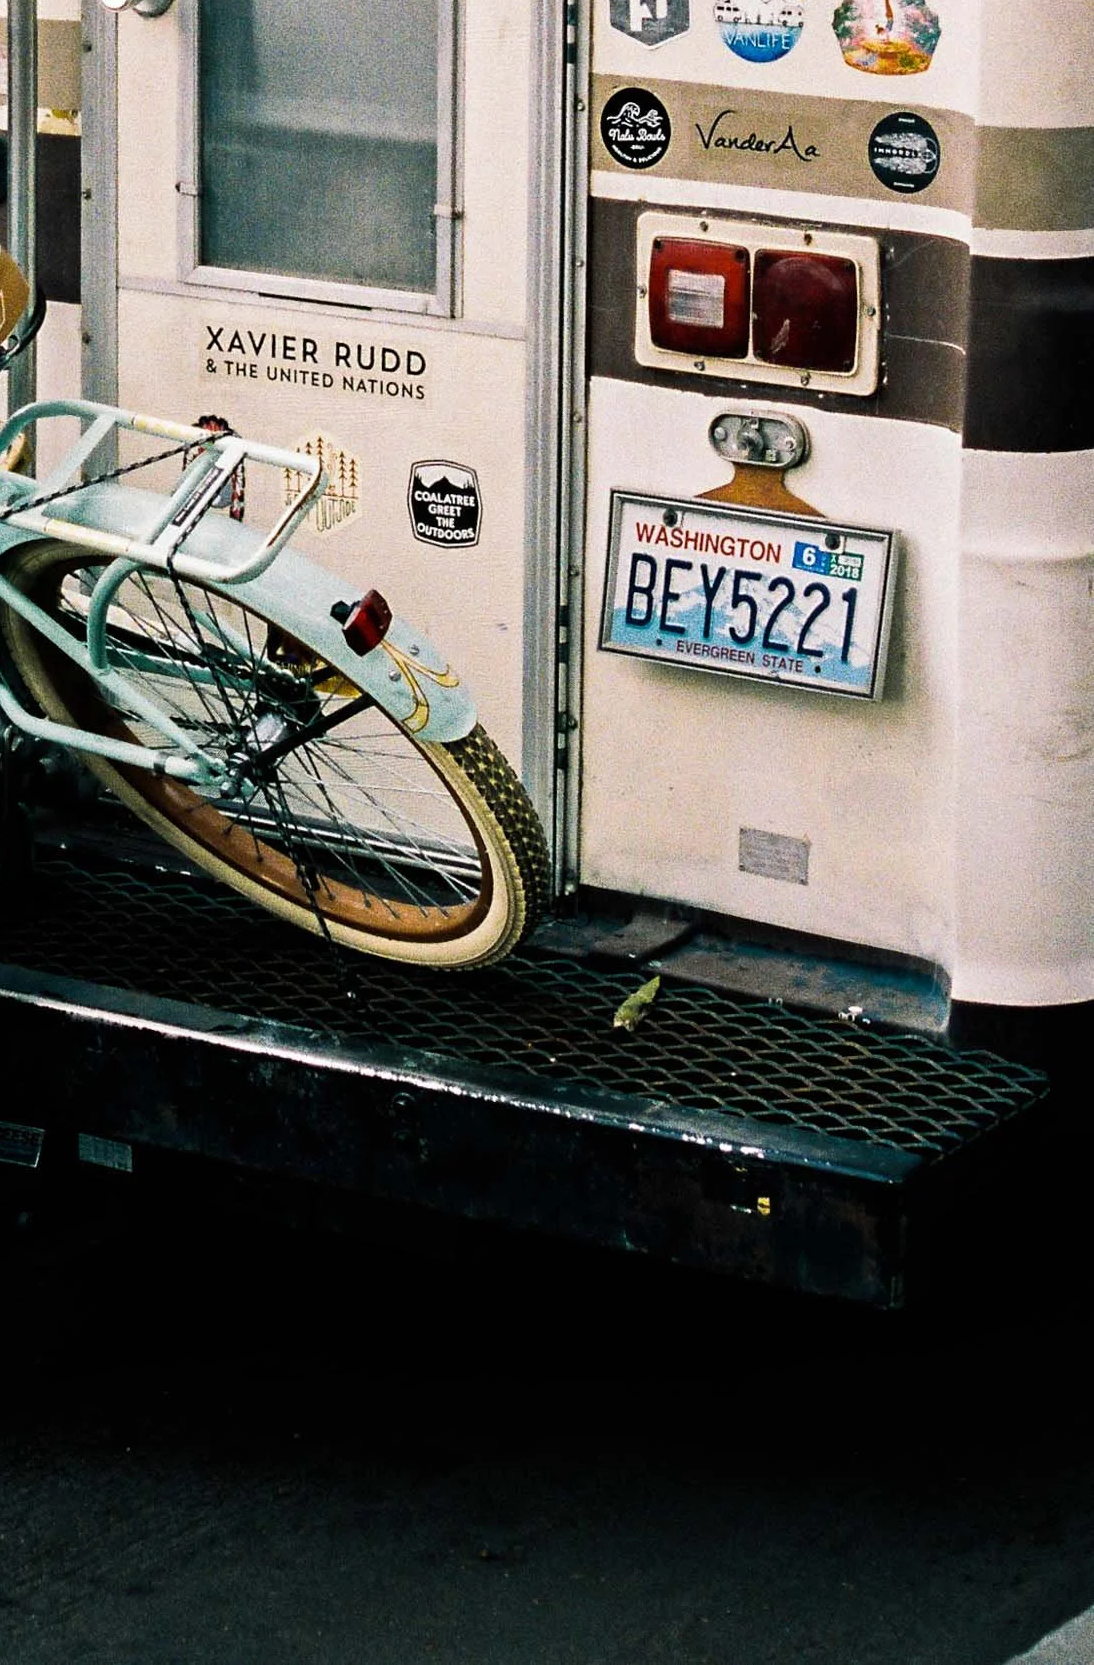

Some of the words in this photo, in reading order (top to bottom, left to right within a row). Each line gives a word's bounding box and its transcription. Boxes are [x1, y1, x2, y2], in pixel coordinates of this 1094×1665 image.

[726, 31, 793, 50] VANLIFE
[206, 325, 318, 363] XAVIER
[335, 341, 426, 376] RUDD
[206, 359, 217, 373] &
[225, 361, 258, 379] THE
[267, 366, 334, 389] UNITED
[342, 377, 426, 400] NATIONS
[414, 490, 475, 507] COALATREE
[428, 503, 462, 518] GREET
[416, 522, 475, 540] OUTDOORS
[436, 517, 455, 528] THE
[635, 522, 782, 564] WASHINGTON
[802, 547, 816, 566] 6
[829, 564, 860, 579] 2018
[625, 552, 857, 665] BEY5221
[675, 640, 755, 665] EVERGREEN
[762, 652, 804, 674] STATE
